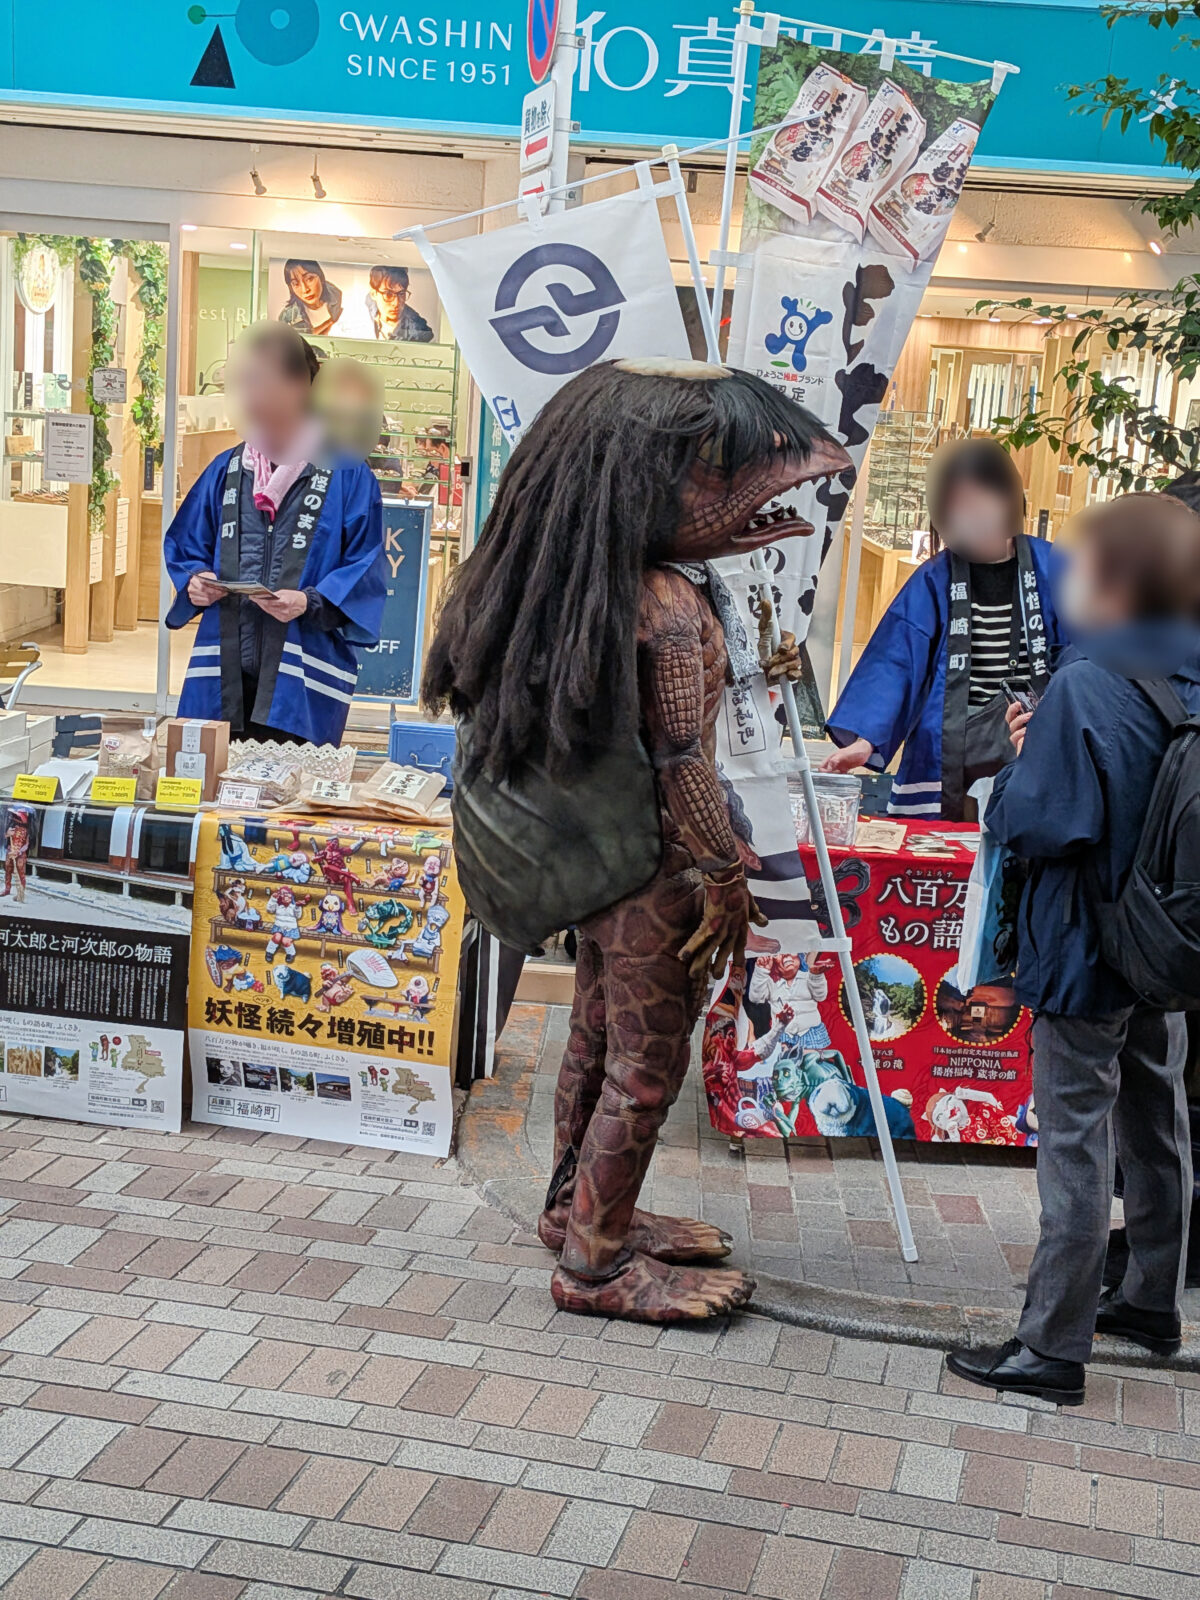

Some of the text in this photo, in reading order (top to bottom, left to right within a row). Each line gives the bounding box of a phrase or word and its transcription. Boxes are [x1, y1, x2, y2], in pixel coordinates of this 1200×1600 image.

[339, 11, 512, 51] WASHIN
[347, 54, 510, 86] SINCE 1951
[199, 307, 227, 321] est
[221, 455, 240, 538] 福崎町
[292, 467, 333, 549] 怪のまち
[949, 582, 969, 671] 福崎町
[1023, 570, 1048, 676] 妖怪のまち
[878, 877, 969, 908] 八百万
[879, 917, 966, 949] もの語
[949, 1057, 1001, 1070] NIPPONIA
[236, 1101, 277, 1119] 福崎町
